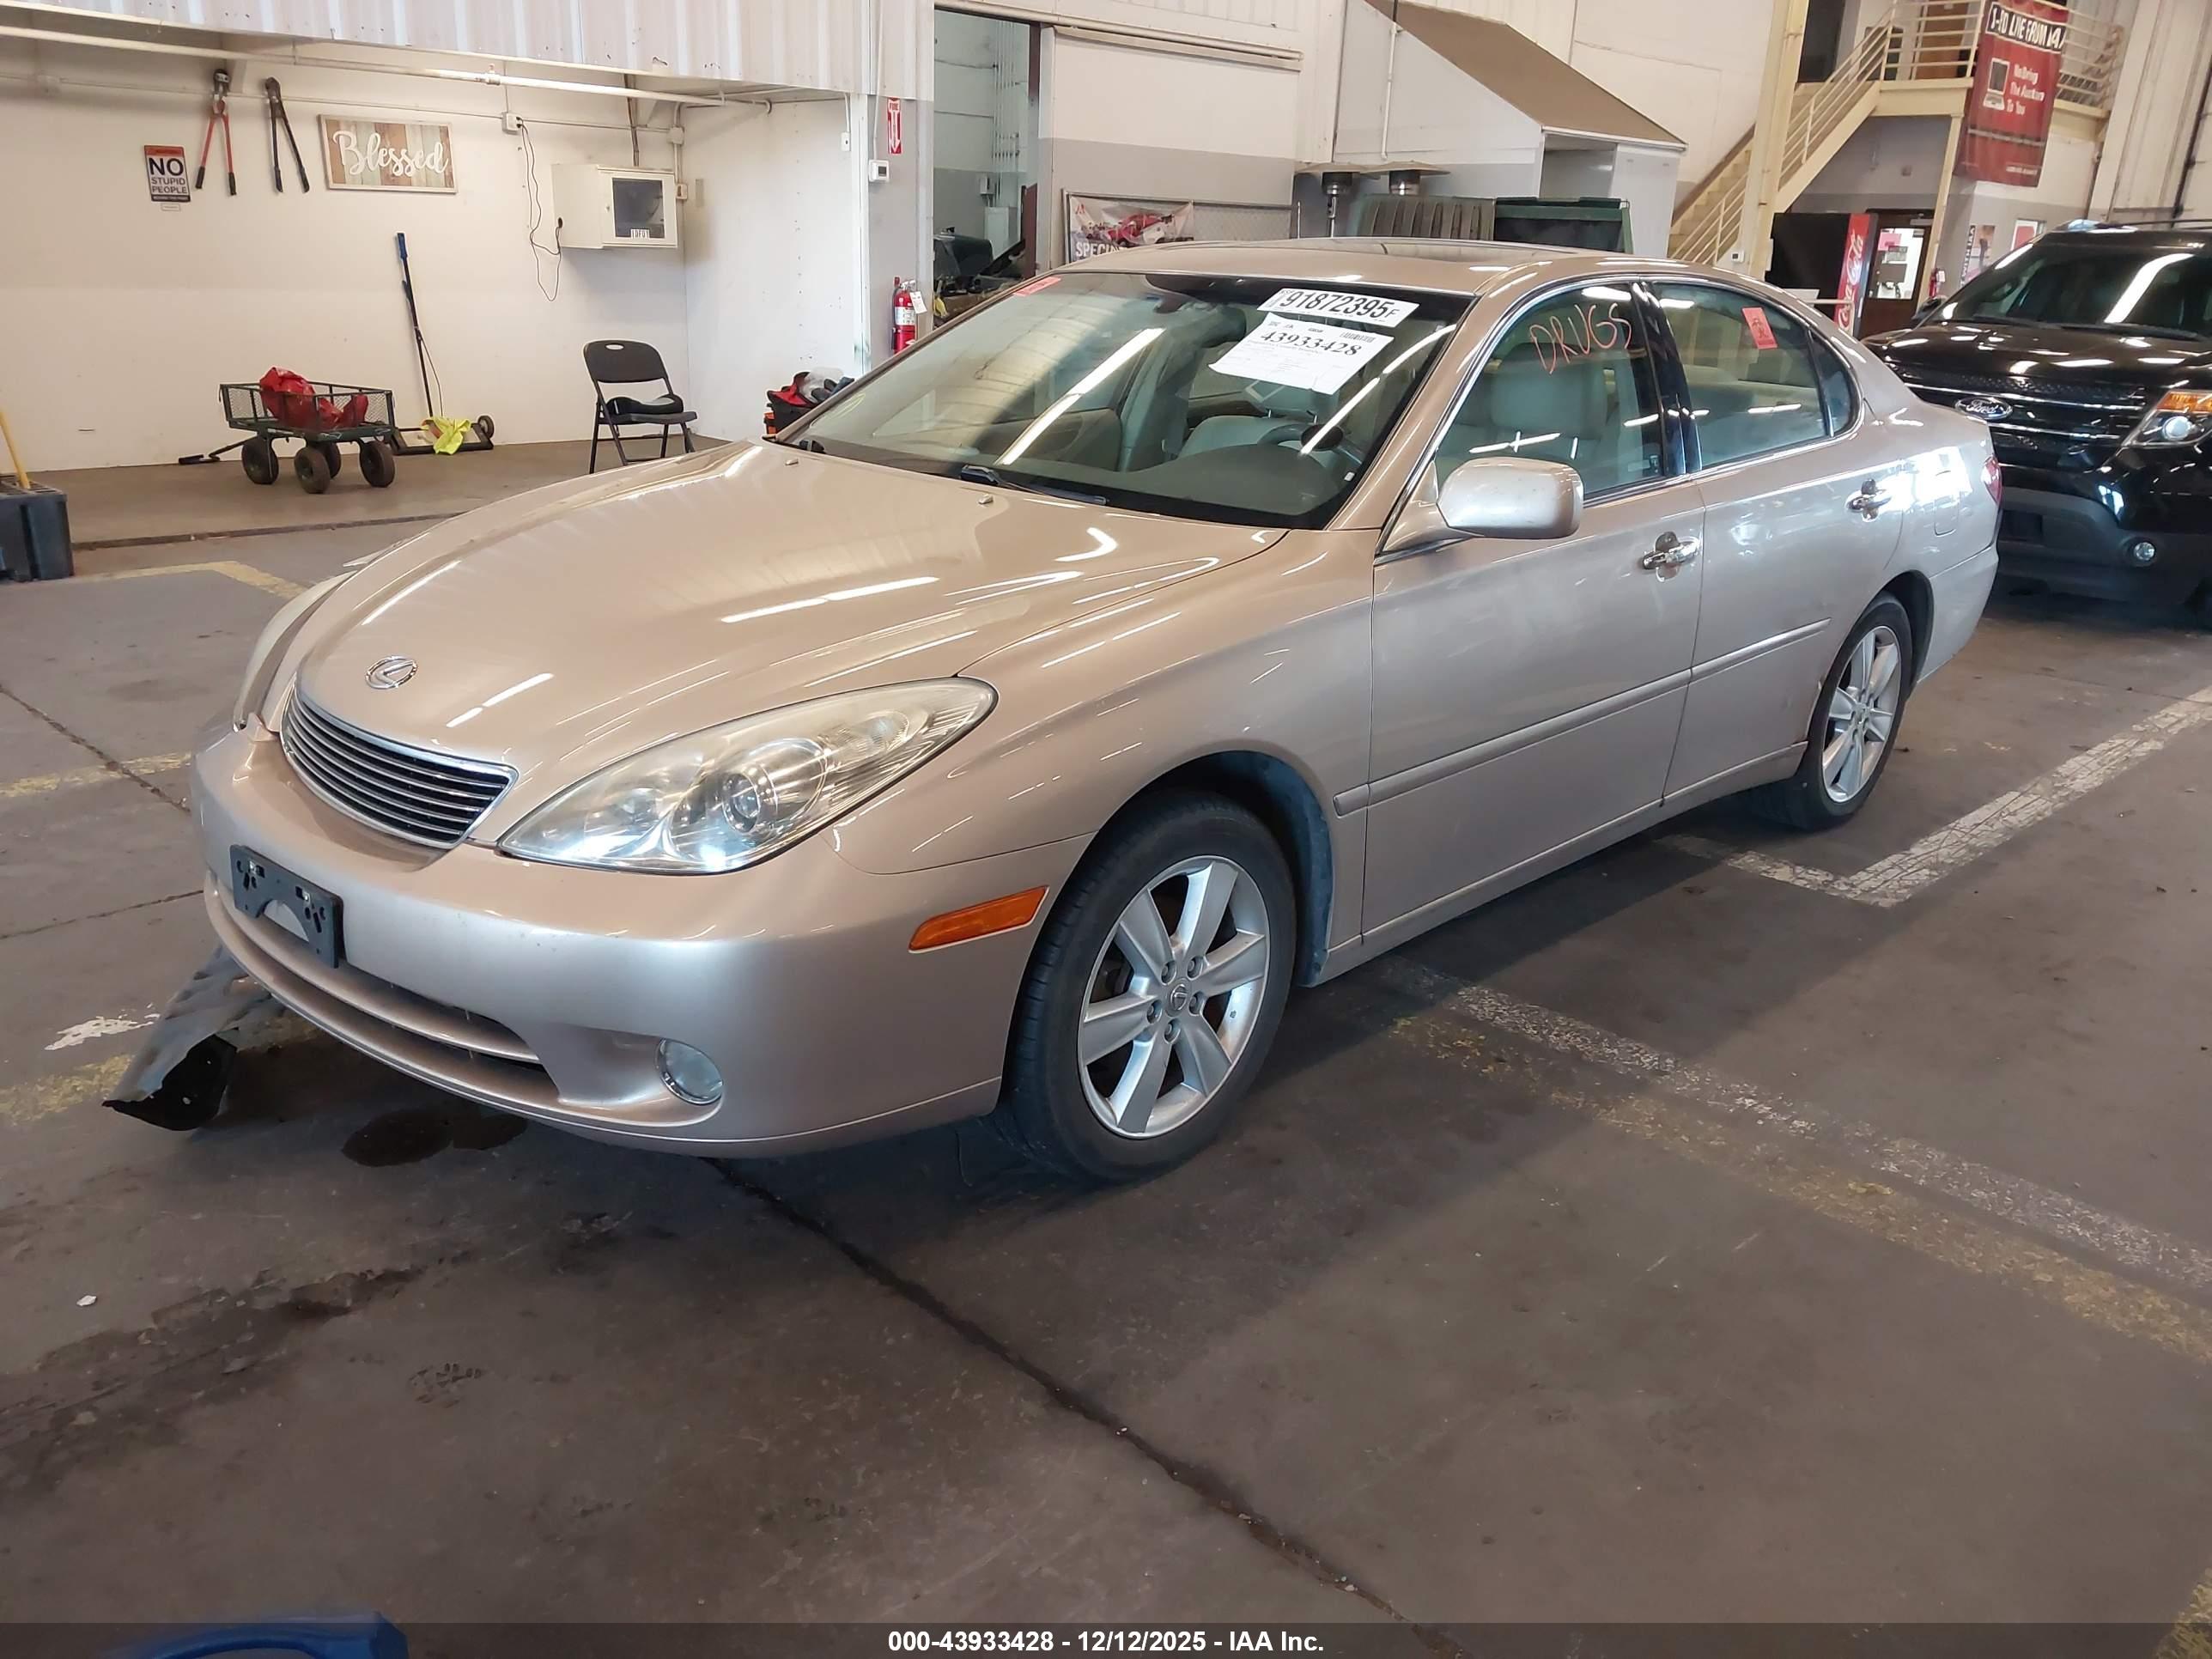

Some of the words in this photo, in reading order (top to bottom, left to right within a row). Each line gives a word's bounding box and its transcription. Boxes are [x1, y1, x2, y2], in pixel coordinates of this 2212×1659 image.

[332, 130, 449, 177] Blessed
[149, 157, 184, 176] NO
[151, 177, 185, 185] STUPID
[152, 185, 188, 194] PEOPLE
[1279, 291, 1395, 319] 91872395
[1261, 331, 1362, 356] 43933428
[1528, 302, 1632, 374] DRUGS
[1966, 398, 1999, 413] Ford
